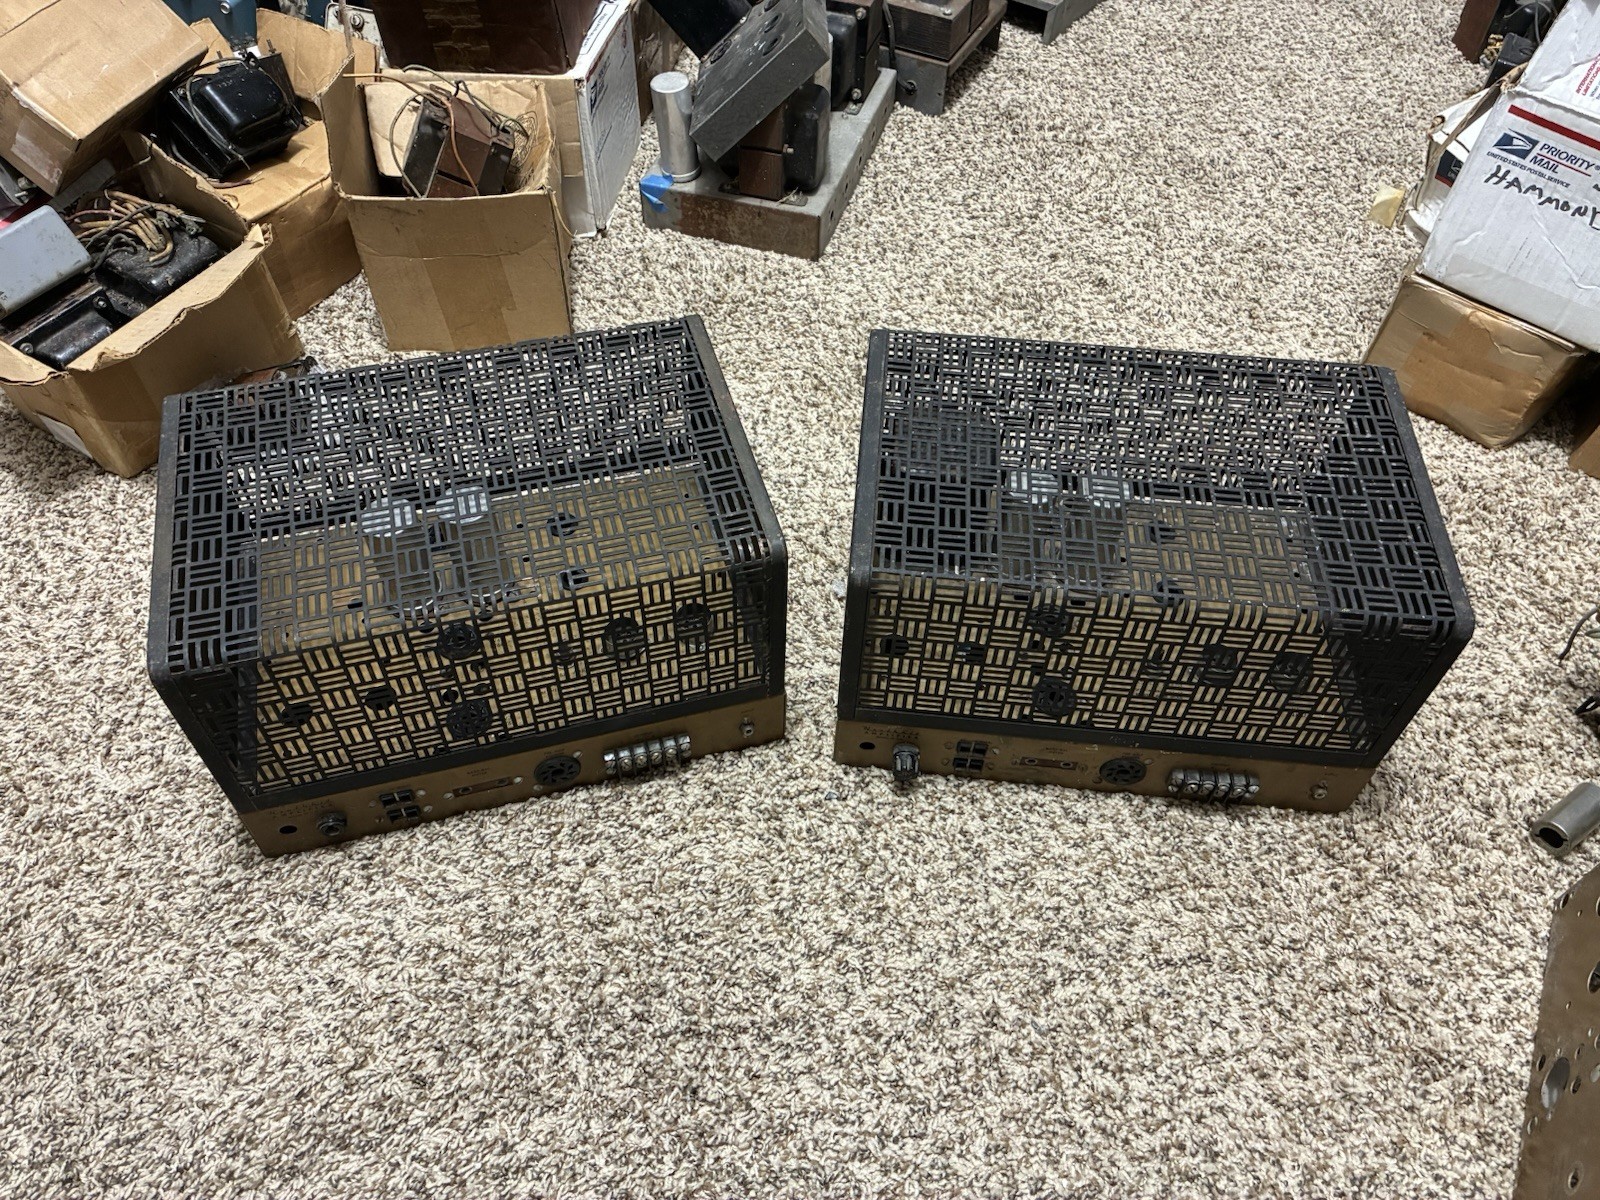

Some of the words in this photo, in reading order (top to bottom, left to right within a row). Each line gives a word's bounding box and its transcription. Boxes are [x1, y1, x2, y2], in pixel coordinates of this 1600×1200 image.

[1486, 151, 1510, 163] UNITED
[1507, 157, 1527, 171] STATES
[1526, 165, 1547, 180] POSTAL
[1545, 174, 1571, 188] SERVICE
[1529, 155, 1559, 174] MAIL
[1540, 143, 1595, 170] PRIORITY
